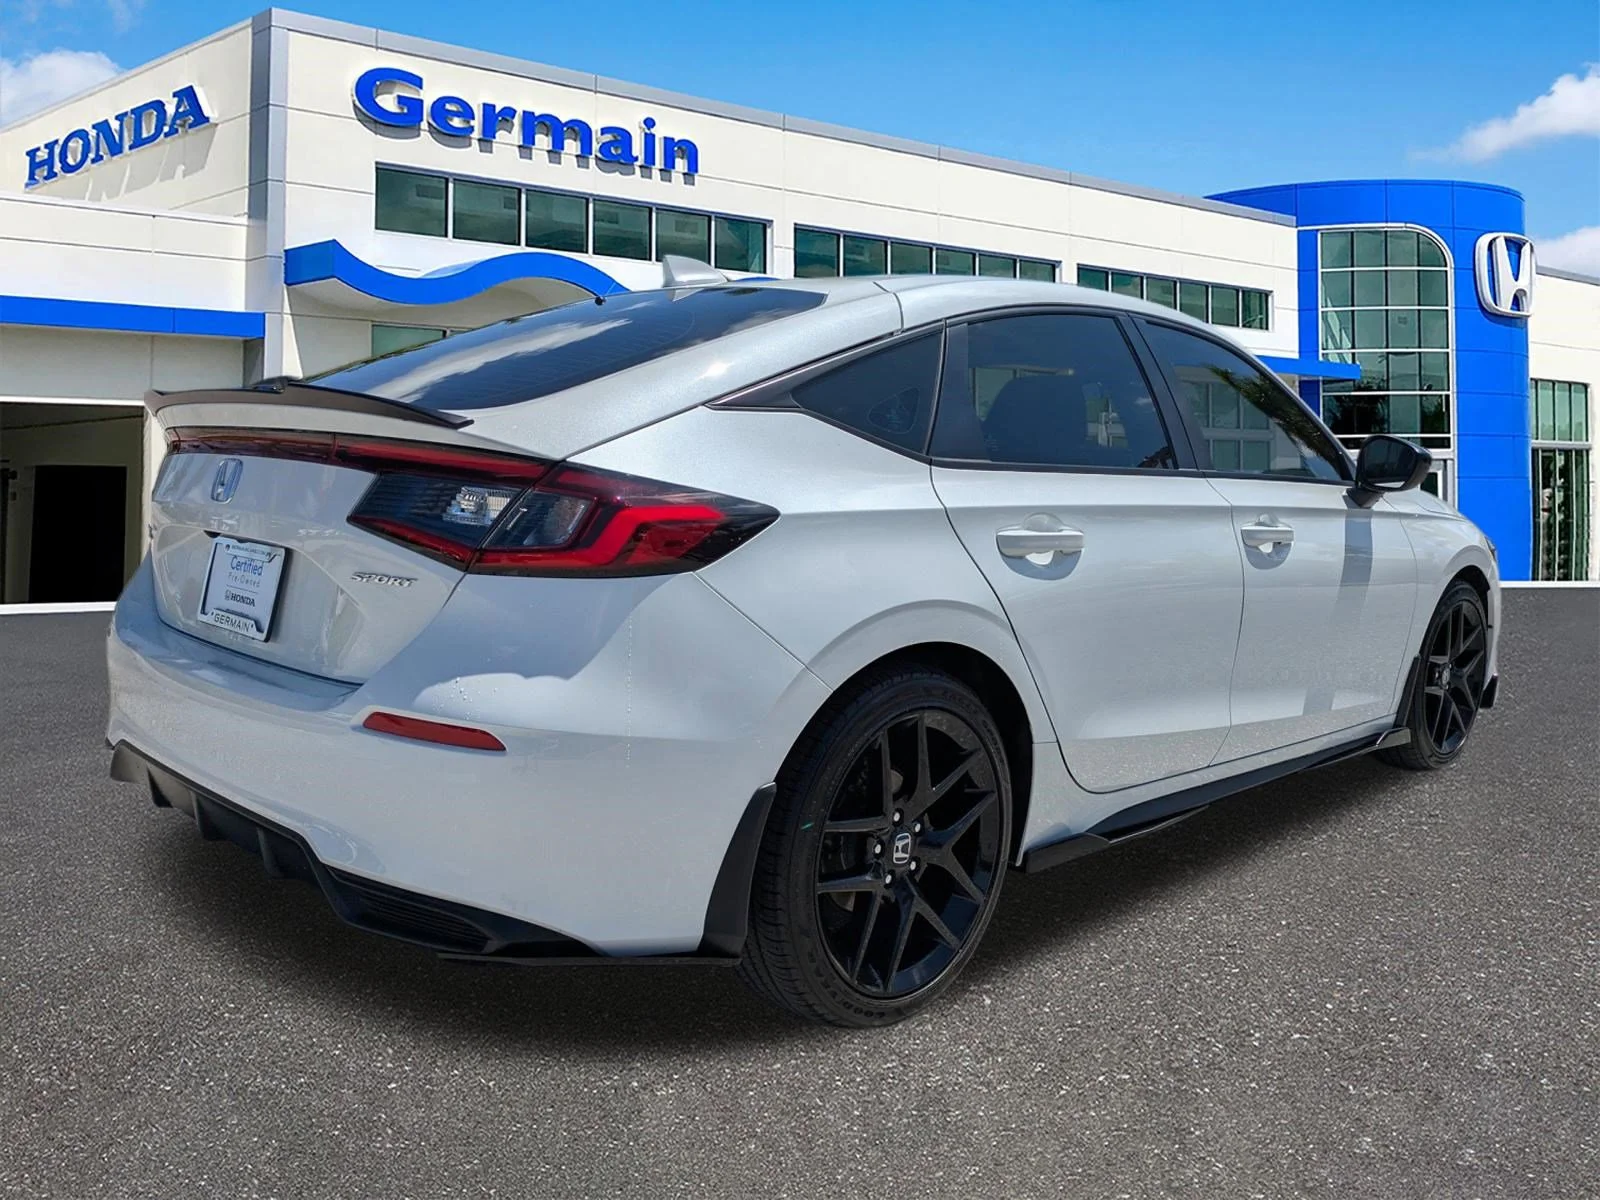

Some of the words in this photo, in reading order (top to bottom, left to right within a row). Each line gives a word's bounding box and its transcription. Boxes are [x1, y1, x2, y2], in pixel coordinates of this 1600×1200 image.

[354, 67, 698, 174] Germain
[25, 85, 209, 188] HONDA
[230, 556, 264, 576] Certified
[351, 572, 417, 587] SPORT
[230, 593, 255, 607] HONDA
[214, 613, 250, 633] GERMAIN
